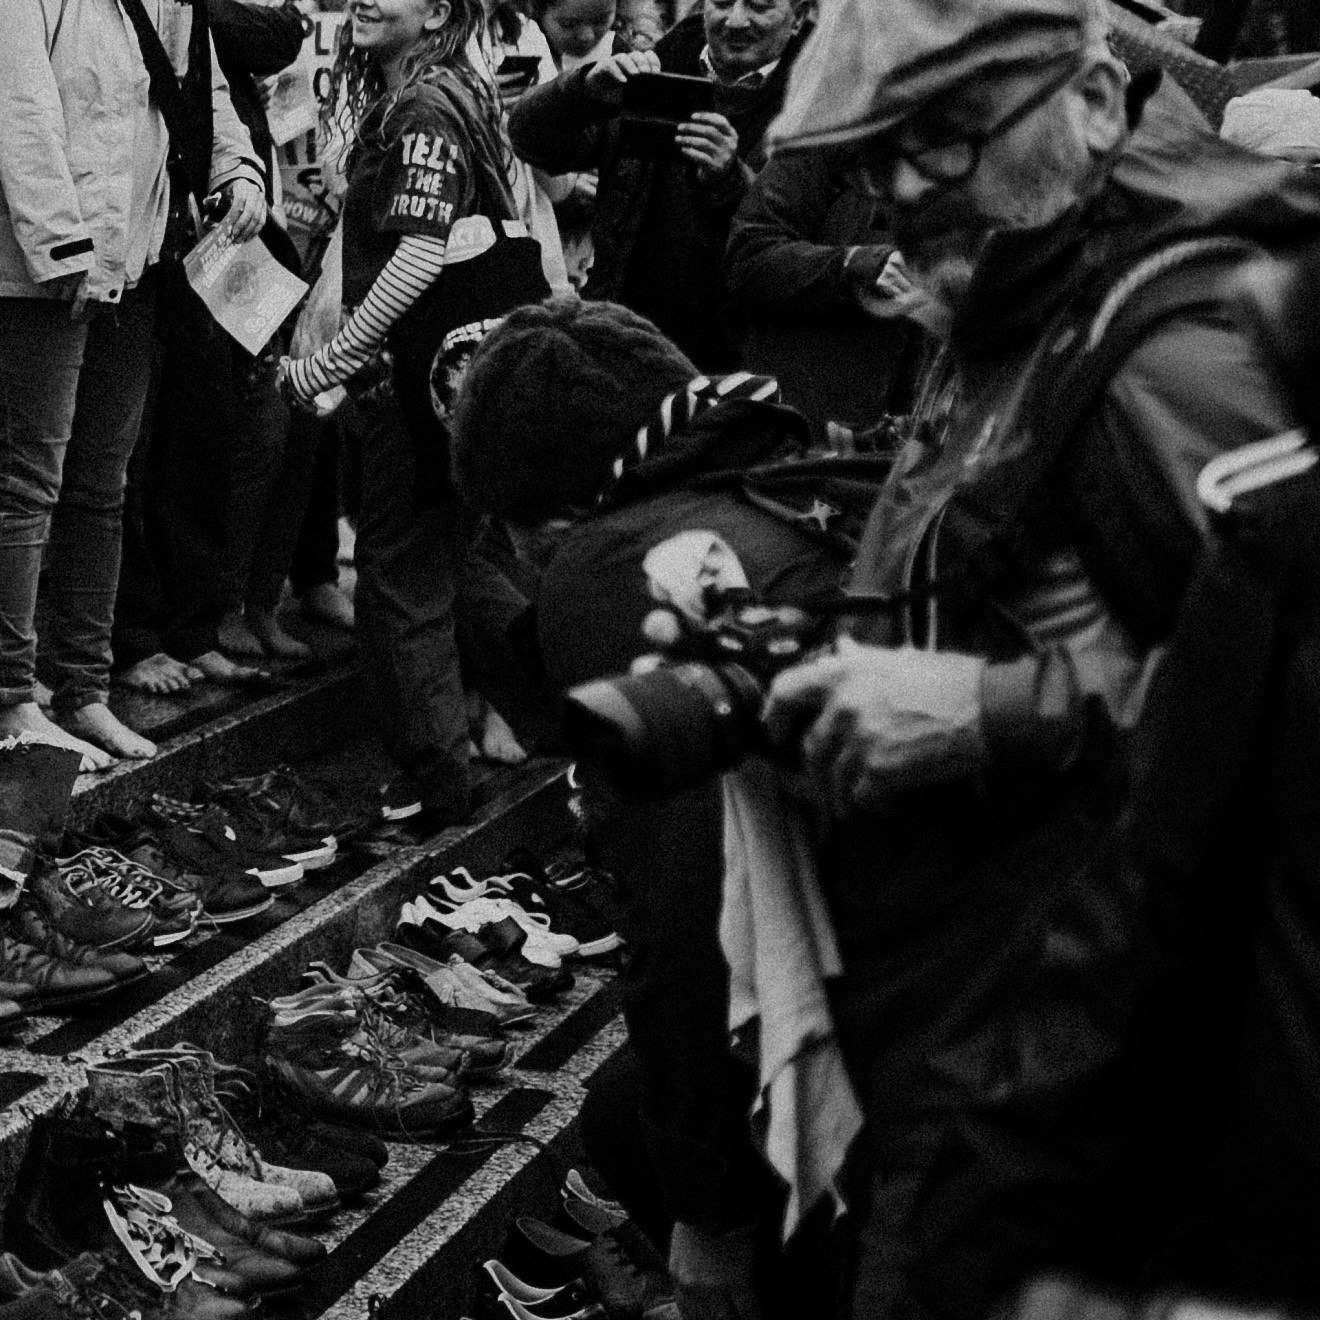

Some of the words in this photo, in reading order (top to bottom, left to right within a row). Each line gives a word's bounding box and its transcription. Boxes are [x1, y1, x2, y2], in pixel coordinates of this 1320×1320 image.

[402, 133, 458, 174] TELL
[406, 167, 443, 195] THE
[390, 193, 454, 224] TRUTH
